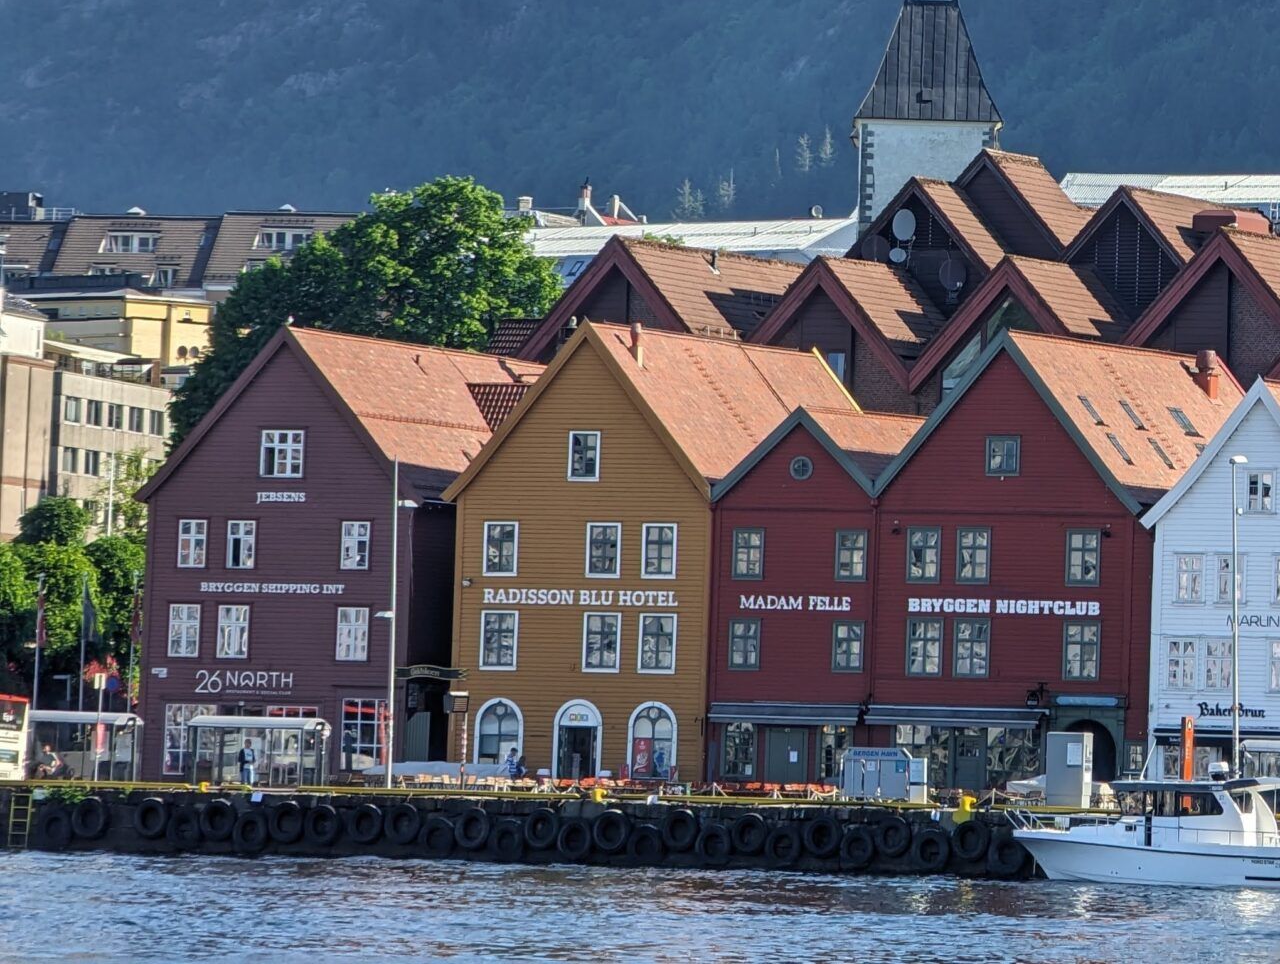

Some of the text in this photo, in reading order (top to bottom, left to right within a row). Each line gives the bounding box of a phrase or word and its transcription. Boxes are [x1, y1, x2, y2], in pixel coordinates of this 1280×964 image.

[256, 492, 306, 504] JEBSENS
[200, 582, 345, 594] BRYGGEN SHIPPING INT
[483, 588, 678, 607] RADISSON BLU HOTEL
[740, 595, 852, 611] MADAM FELLE
[908, 598, 1100, 616] BRYGGEN NIGHTCLUB
[195, 670, 294, 693] 26 NORTH
[1196, 701, 1233, 720] Baker
[853, 749, 879, 757] BERGEN
